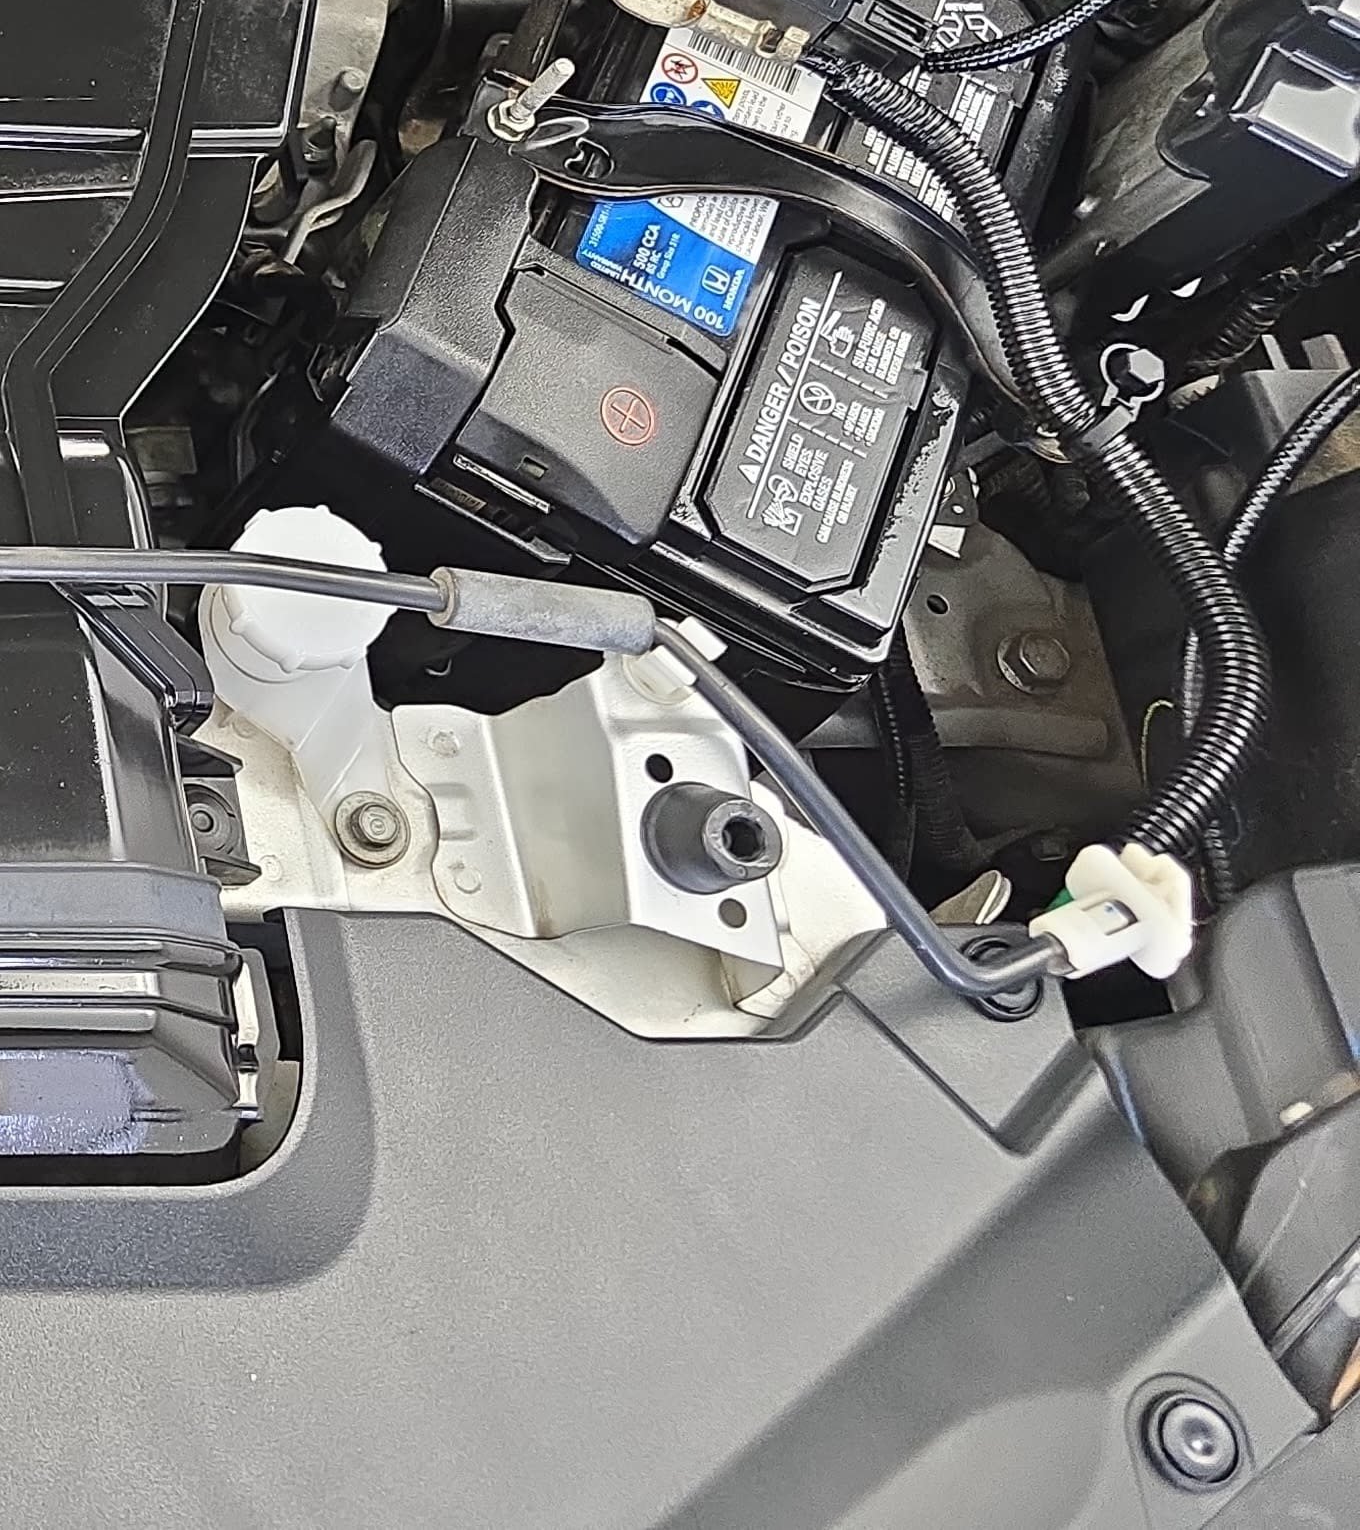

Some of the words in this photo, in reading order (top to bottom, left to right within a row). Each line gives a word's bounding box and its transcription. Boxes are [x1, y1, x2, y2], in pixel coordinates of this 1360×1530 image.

[640, 220, 662, 248] CCA
[589, 258, 620, 279] LIMITED
[631, 243, 653, 270] 500
[618, 265, 693, 313] MONTH
[721, 265, 746, 311] HONDA
[691, 302, 727, 330] 100
[851, 320, 878, 369] SULFURIC
[867, 297, 886, 324] ACID
[831, 401, 848, 420] NO
[853, 405, 873, 438] FLAMES
[781, 431, 805, 470] SHIELD
[793, 446, 814, 477] EYES
[797, 447, 829, 506] EXPLOSIVE
[810, 473, 834, 512] GASES
